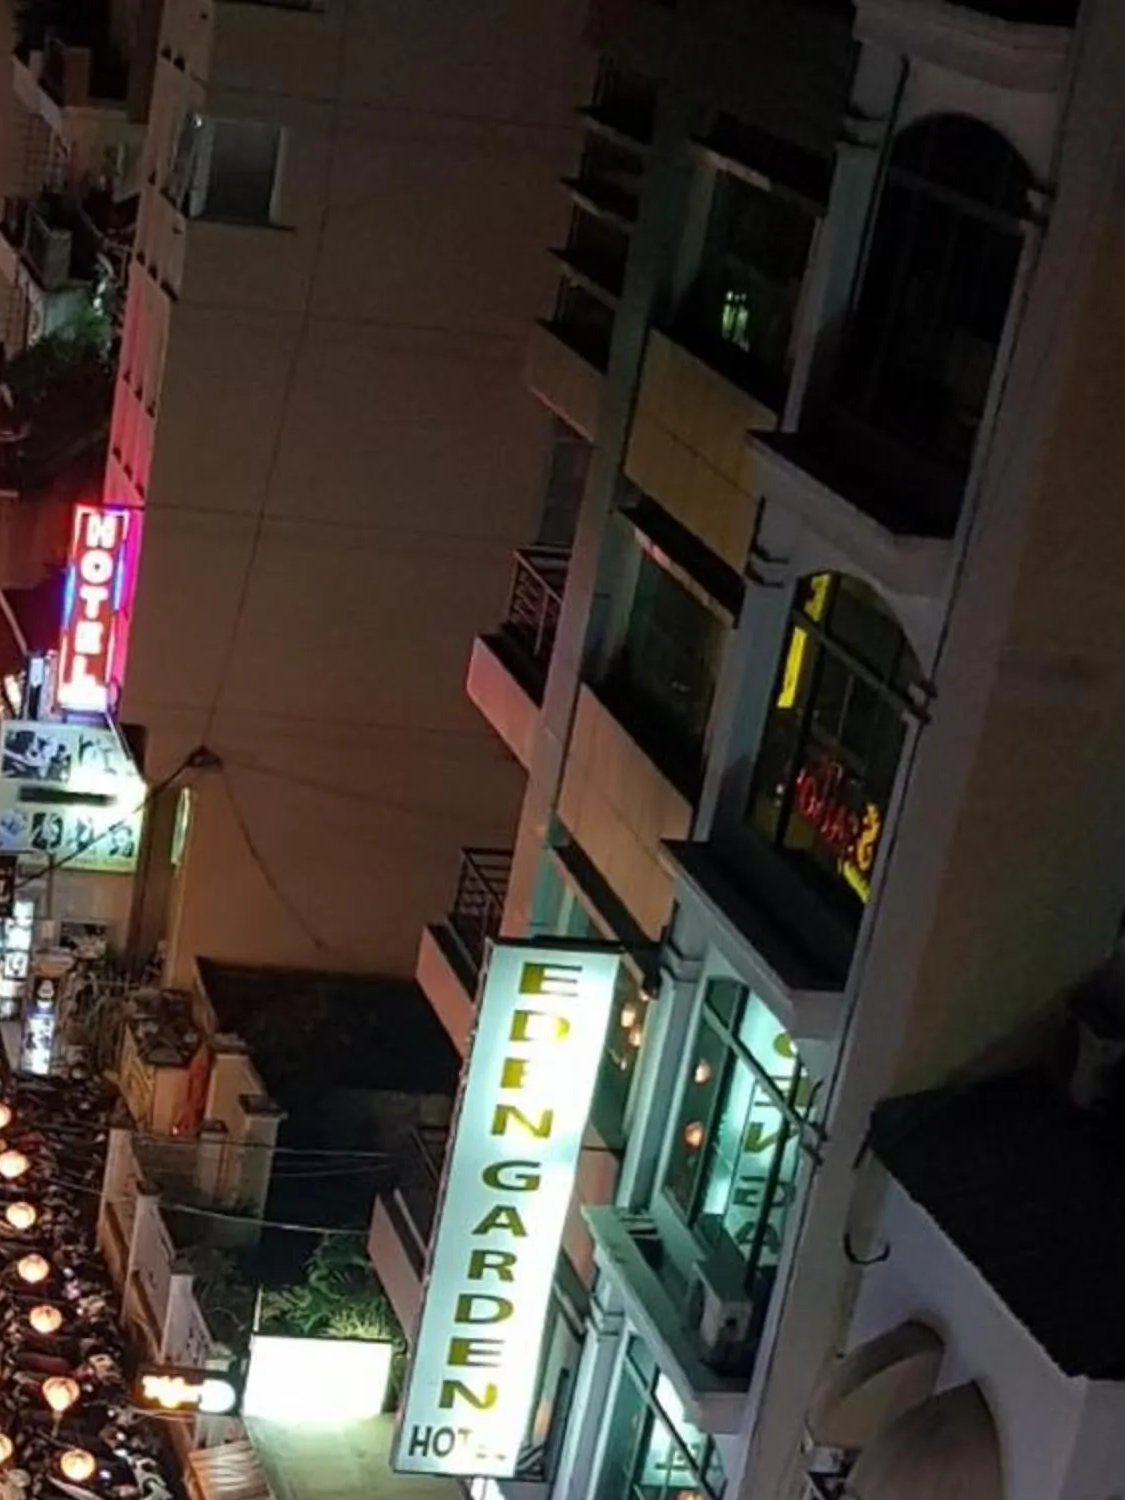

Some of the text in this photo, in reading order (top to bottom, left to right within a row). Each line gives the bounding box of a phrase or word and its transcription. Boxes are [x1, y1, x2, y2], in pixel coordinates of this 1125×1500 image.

[70, 513, 118, 696] HOTEL
[438, 960, 582, 1411] EDEN GARDEN
[407, 1425, 507, 1461] HOT
